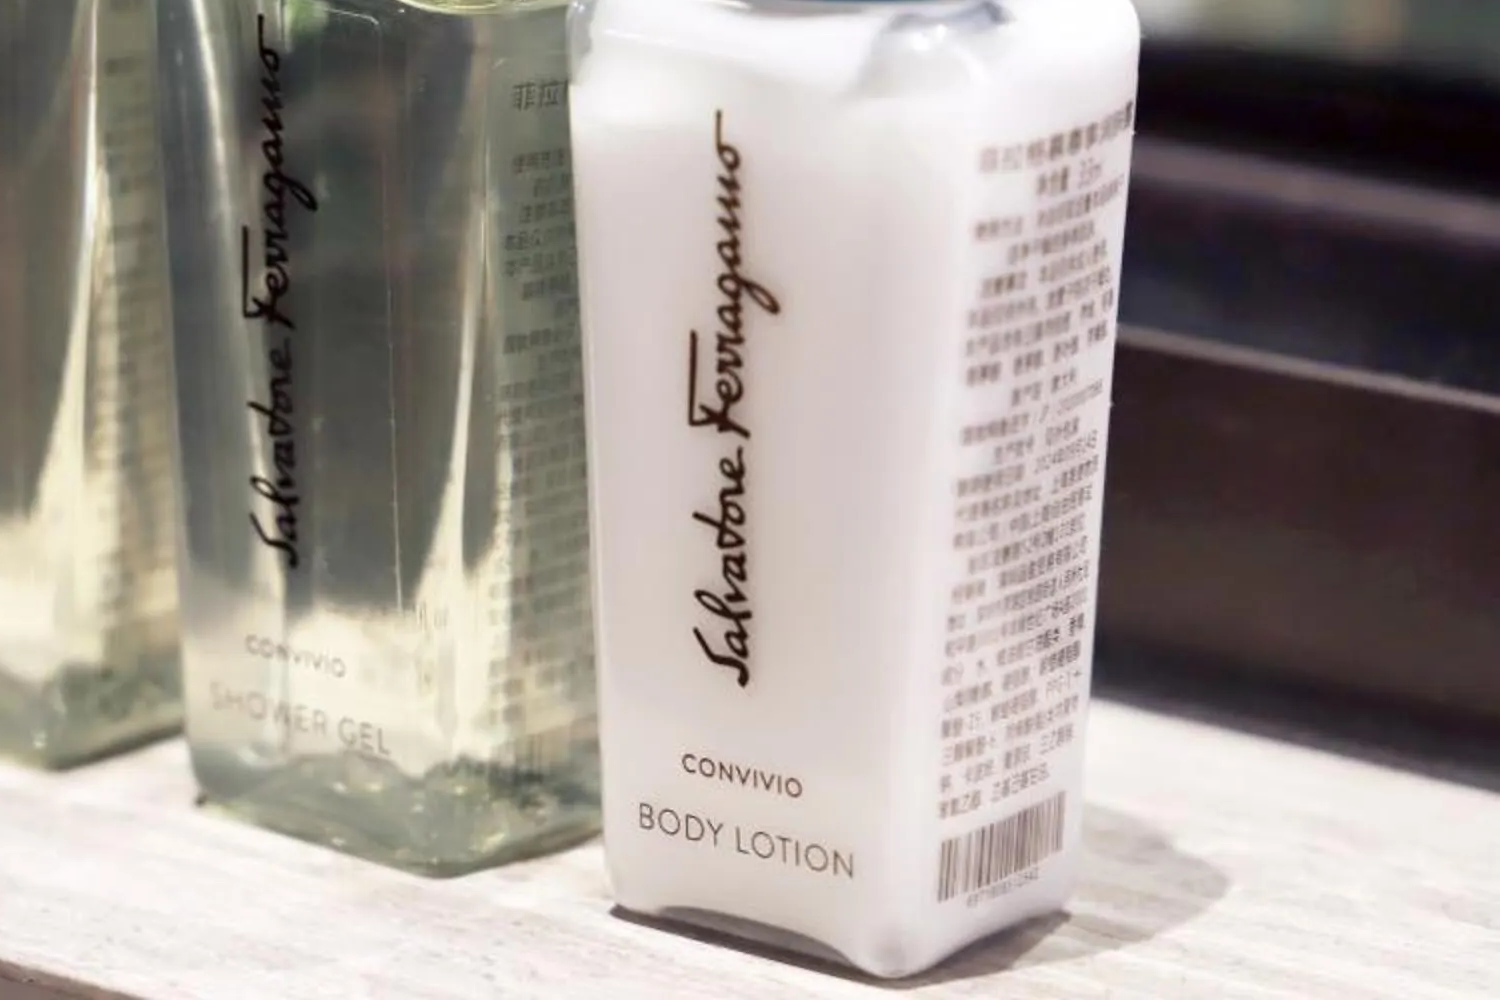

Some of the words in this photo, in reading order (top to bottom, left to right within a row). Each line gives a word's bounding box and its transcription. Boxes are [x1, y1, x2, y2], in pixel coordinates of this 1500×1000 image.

[243, 14, 318, 329] Ferragamo
[687, 109, 781, 441] Ferragamo
[247, 339, 299, 569] Salvatore
[692, 448, 753, 687] Salvatore
[209, 681, 328, 738] SHOWER
[337, 715, 392, 756] GEL
[245, 633, 348, 678] CONVIVIO
[638, 802, 724, 848] BODY
[734, 829, 855, 879] LOTION
[680, 752, 804, 799] CONVIVIO
